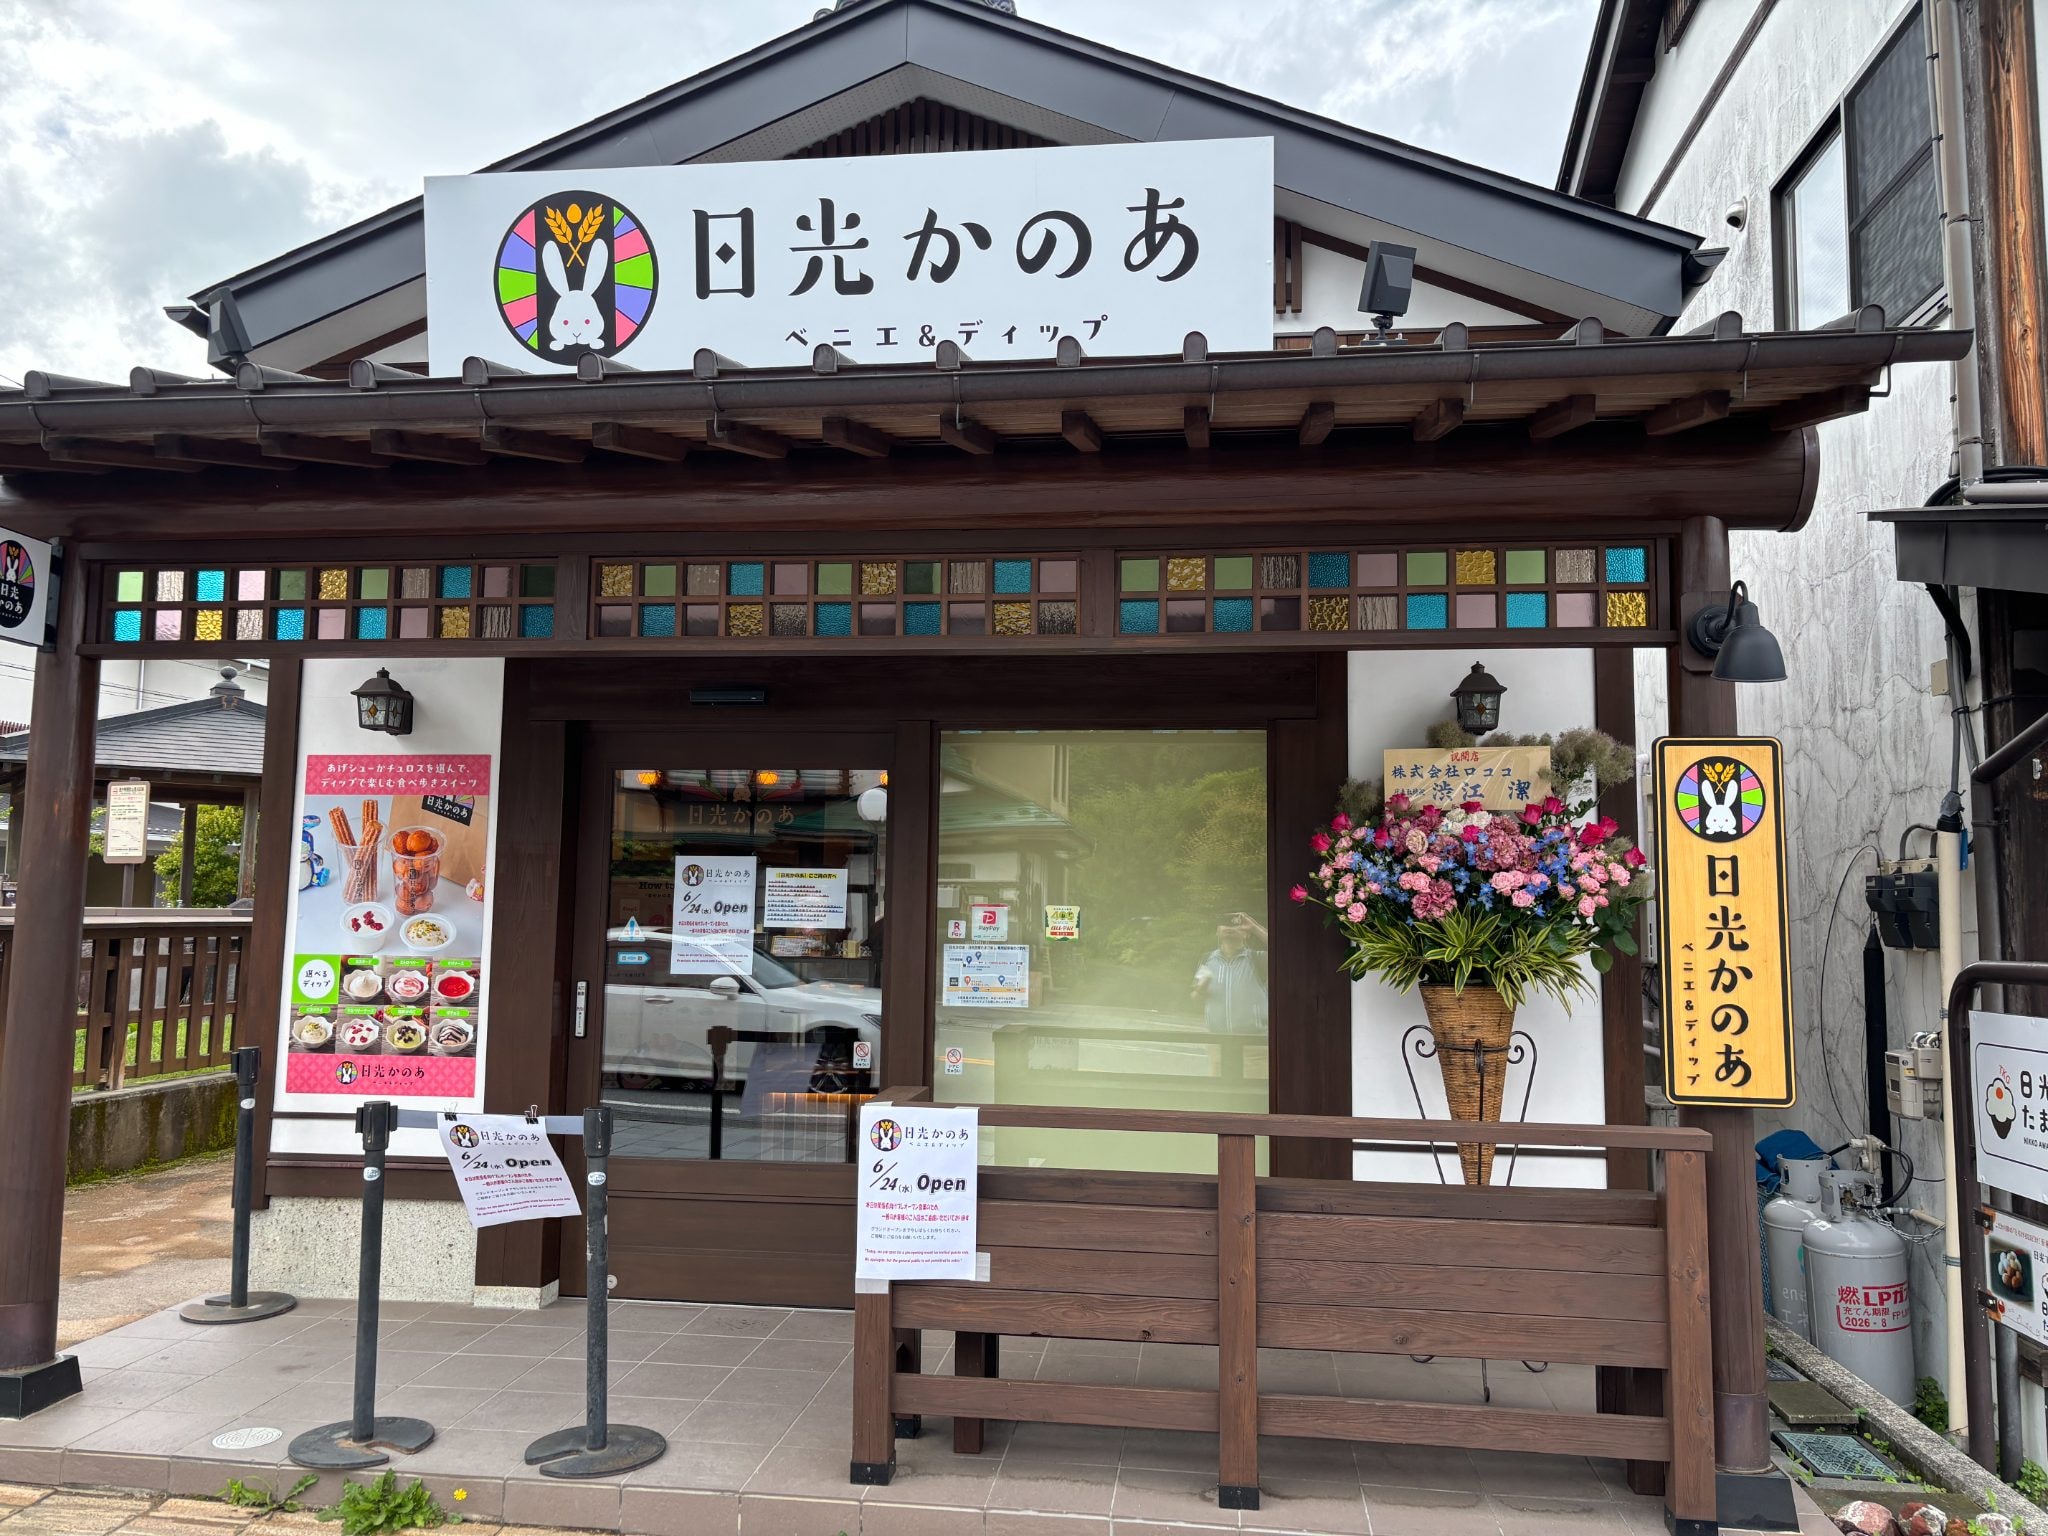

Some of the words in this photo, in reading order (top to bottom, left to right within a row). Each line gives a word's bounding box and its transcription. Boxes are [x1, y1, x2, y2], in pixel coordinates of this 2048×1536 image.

[692, 187, 1200, 300] 日光かのあ
[784, 313, 1110, 349] ベニエ&ディップ
[1, 582, 20, 600] 日光
[1451, 751, 1480, 762] 祝開店
[1391, 764, 1512, 779] 株式会社ロココ
[320, 777, 478, 788] ディップで楽しむ食べ歩きスイーツ
[1432, 780, 1485, 801] 渋江
[1508, 779, 1532, 801] 潔
[427, 795, 468, 818] 日光かのあ
[688, 804, 795, 825] 日光かのあ
[706, 869, 751, 878] 日光かのあ
[714, 900, 749, 916] Open
[305, 970, 328, 978] 選べる
[1705, 854, 1753, 1088] 日光かのあ
[303, 980, 331, 988] ディップ
[1681, 942, 1701, 1087] ベニエ&ディップ
[361, 1064, 425, 1078] 日光かのあ
[481, 1131, 540, 1141] 日光かのあ
[905, 1126, 968, 1140] 日光かのあ
[505, 1158, 552, 1169] Open
[917, 1174, 967, 1194] Open
[1838, 1286, 1860, 1305] 燃
[1842, 1306, 1890, 1317] 充てん期限
[1845, 1316, 1870, 1328] 2026
[1881, 1317, 1887, 1328] 8
